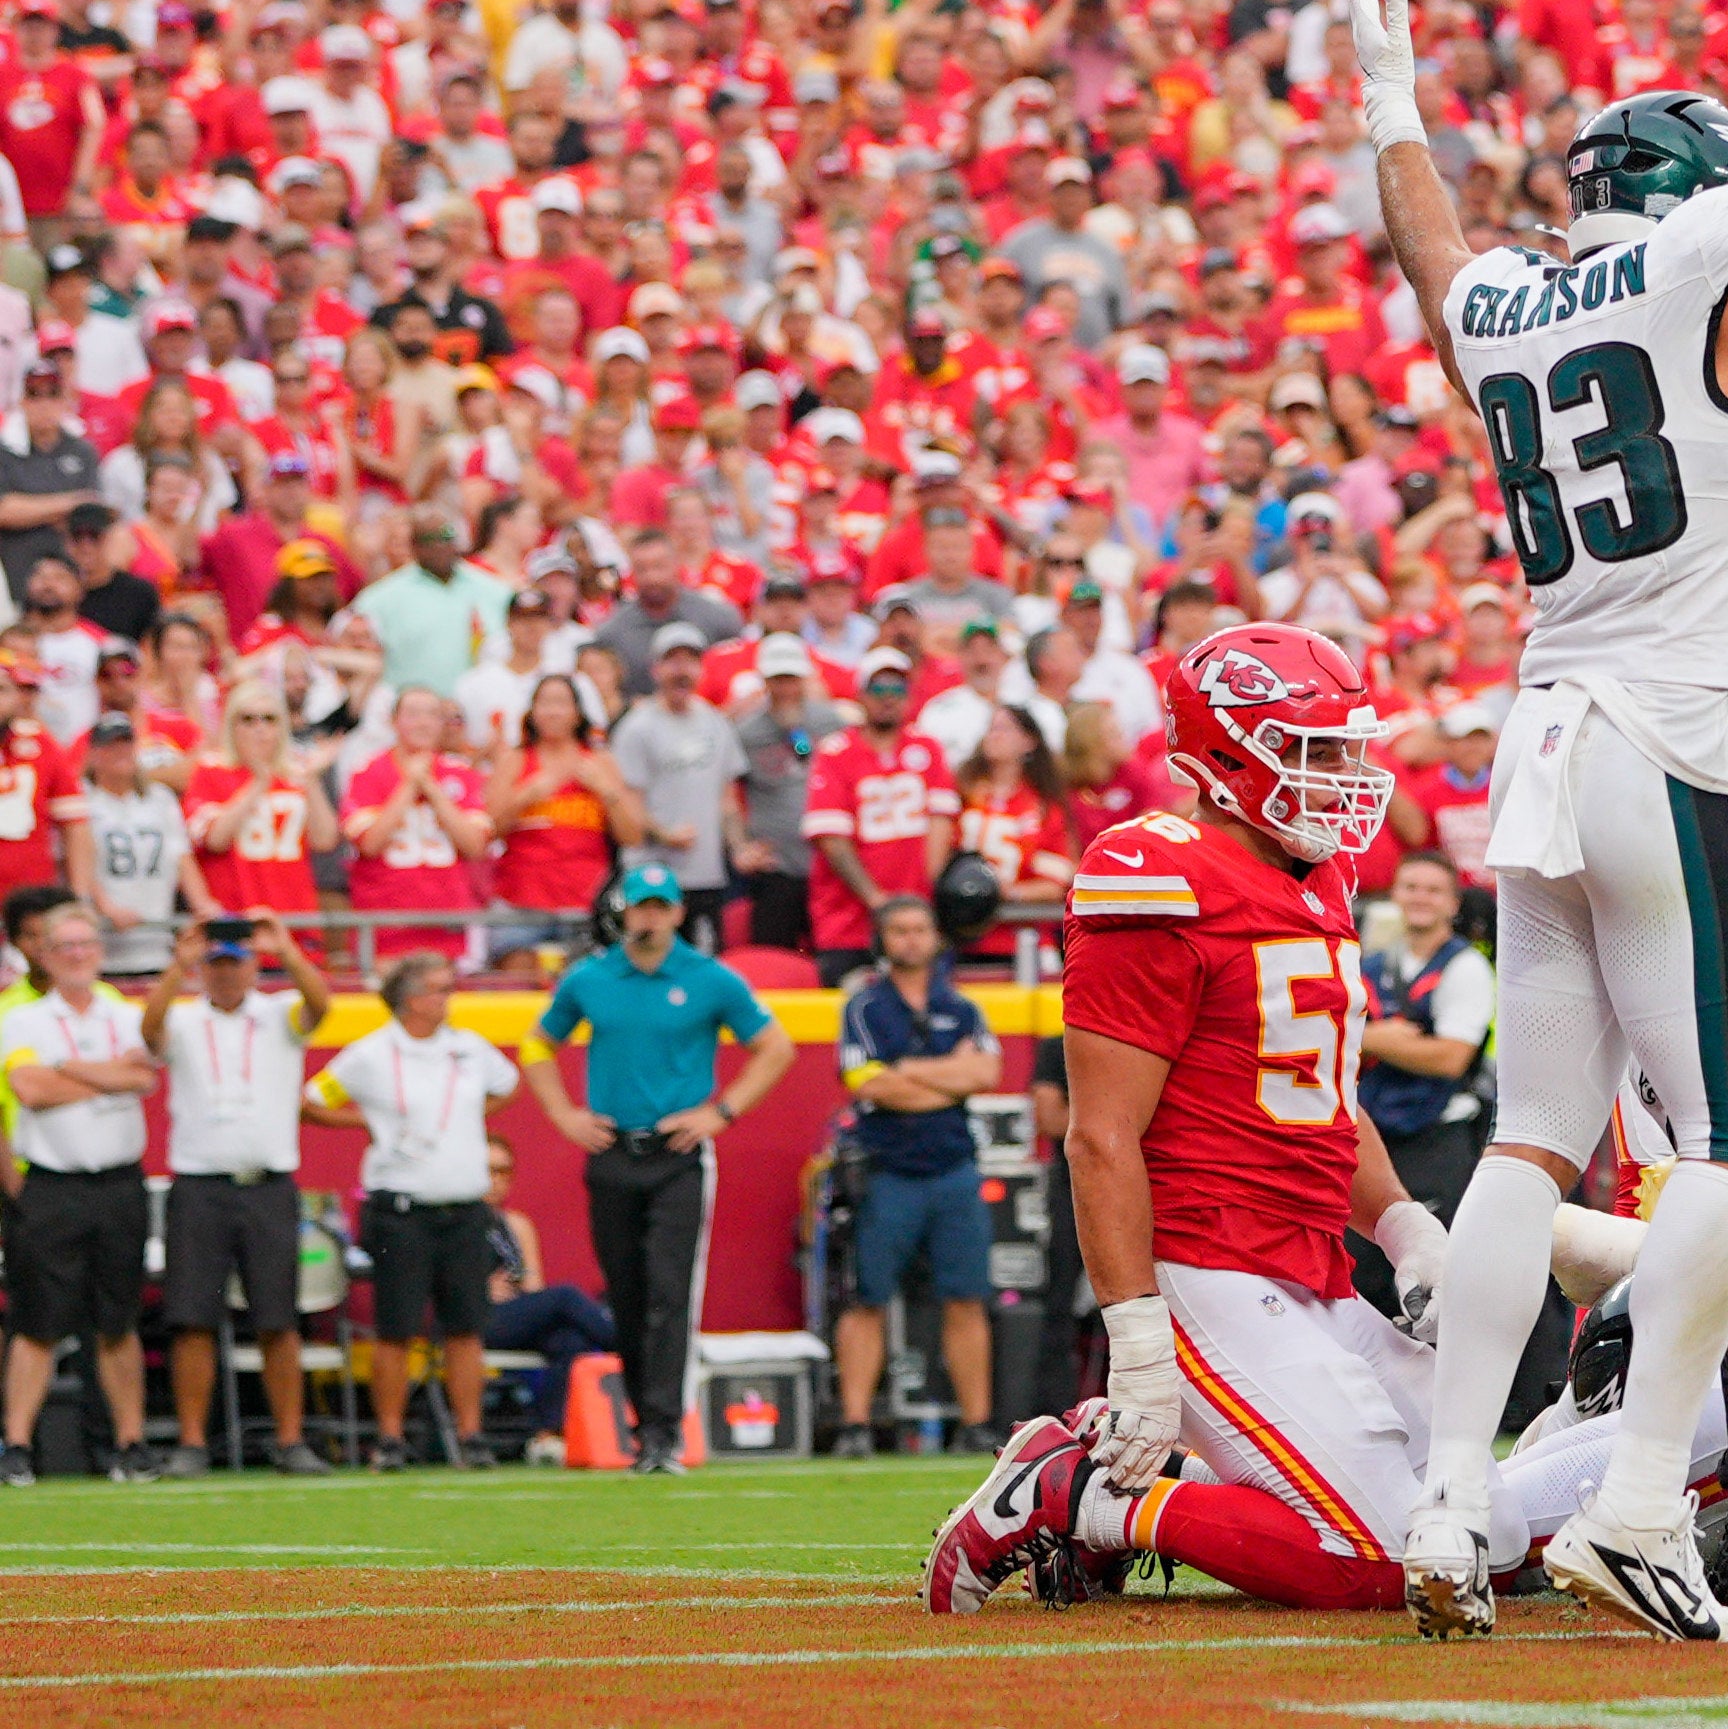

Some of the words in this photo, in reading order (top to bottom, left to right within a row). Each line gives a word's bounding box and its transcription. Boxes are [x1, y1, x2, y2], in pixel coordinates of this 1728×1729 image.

[1478, 341, 1689, 587] 83
[1216, 660, 1275, 700] KC
[857, 772, 928, 843] 22
[105, 828, 163, 879] 87
